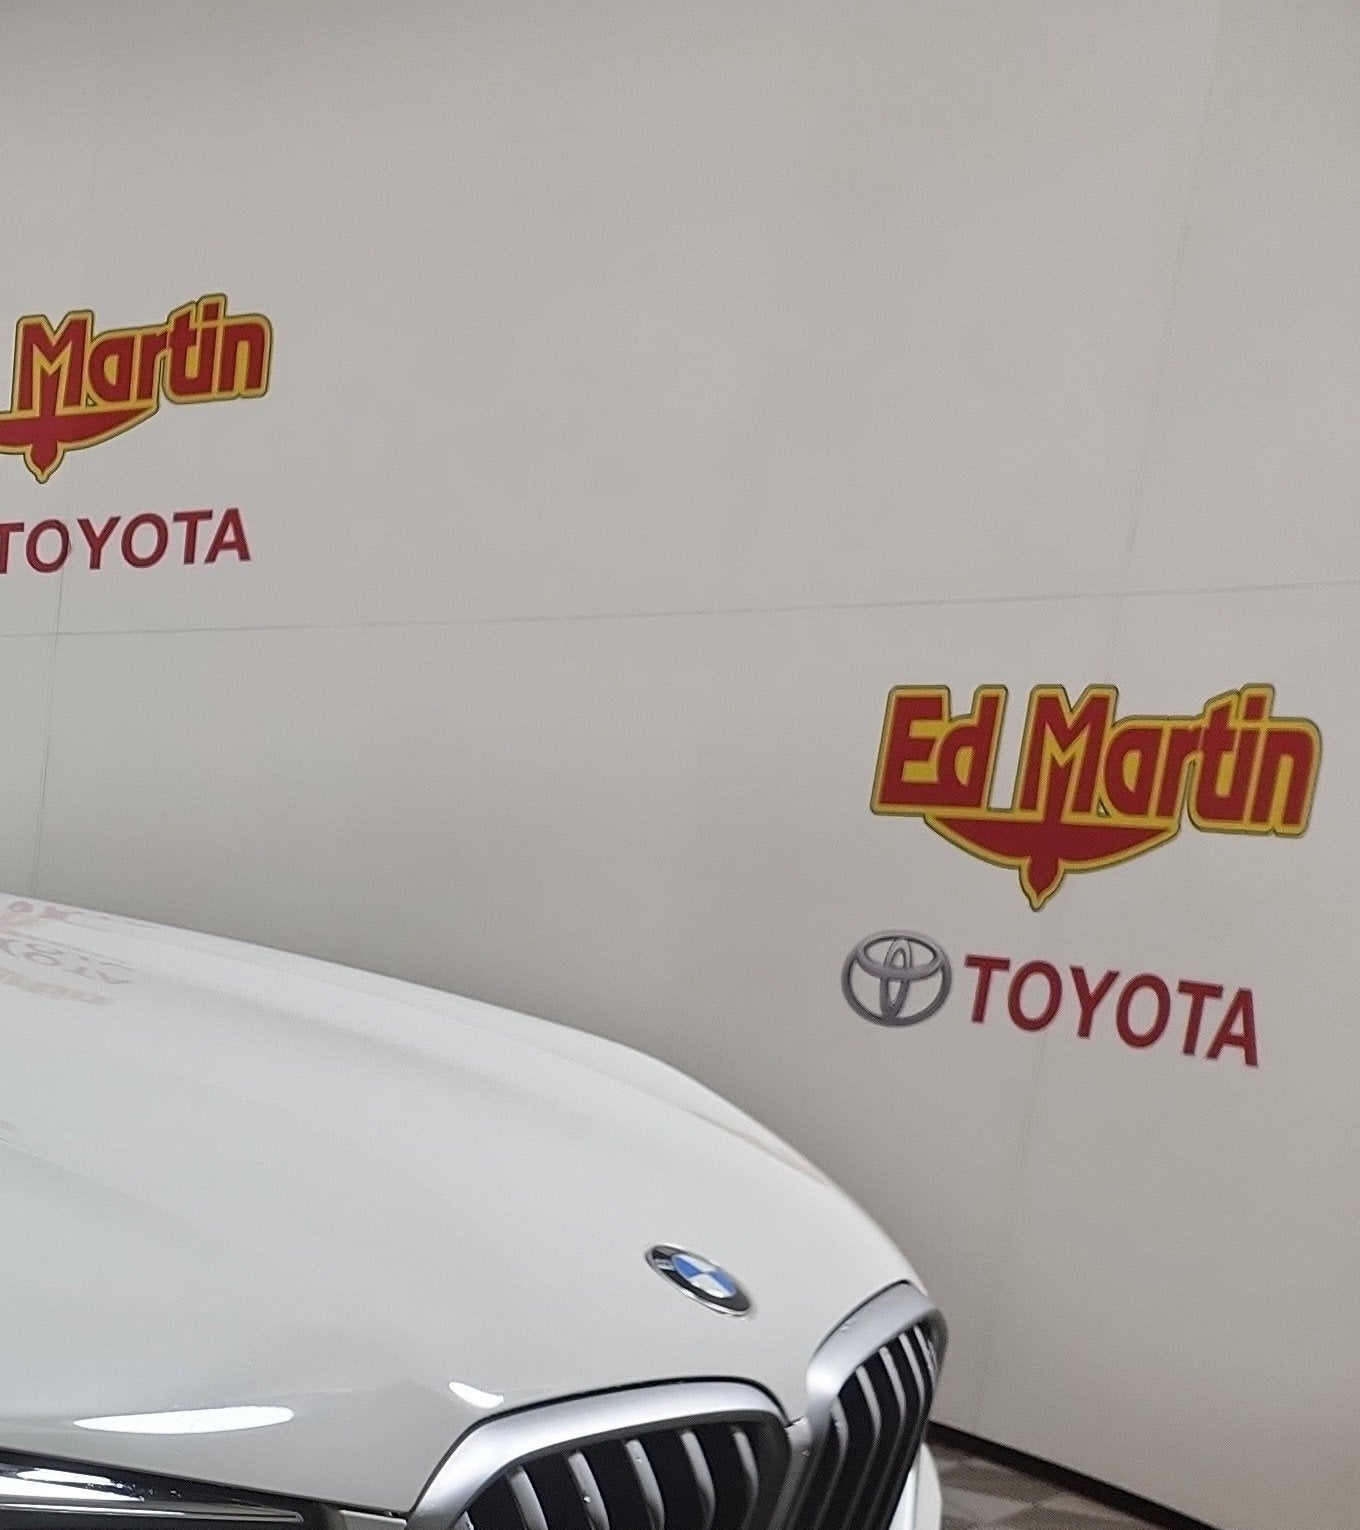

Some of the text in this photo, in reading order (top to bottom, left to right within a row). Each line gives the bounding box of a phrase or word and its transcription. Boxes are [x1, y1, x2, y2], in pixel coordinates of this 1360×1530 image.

[12, 293, 273, 415] Martin
[870, 683, 1322, 837] Ed Martin
[964, 953, 1260, 1067] TOYOTA
